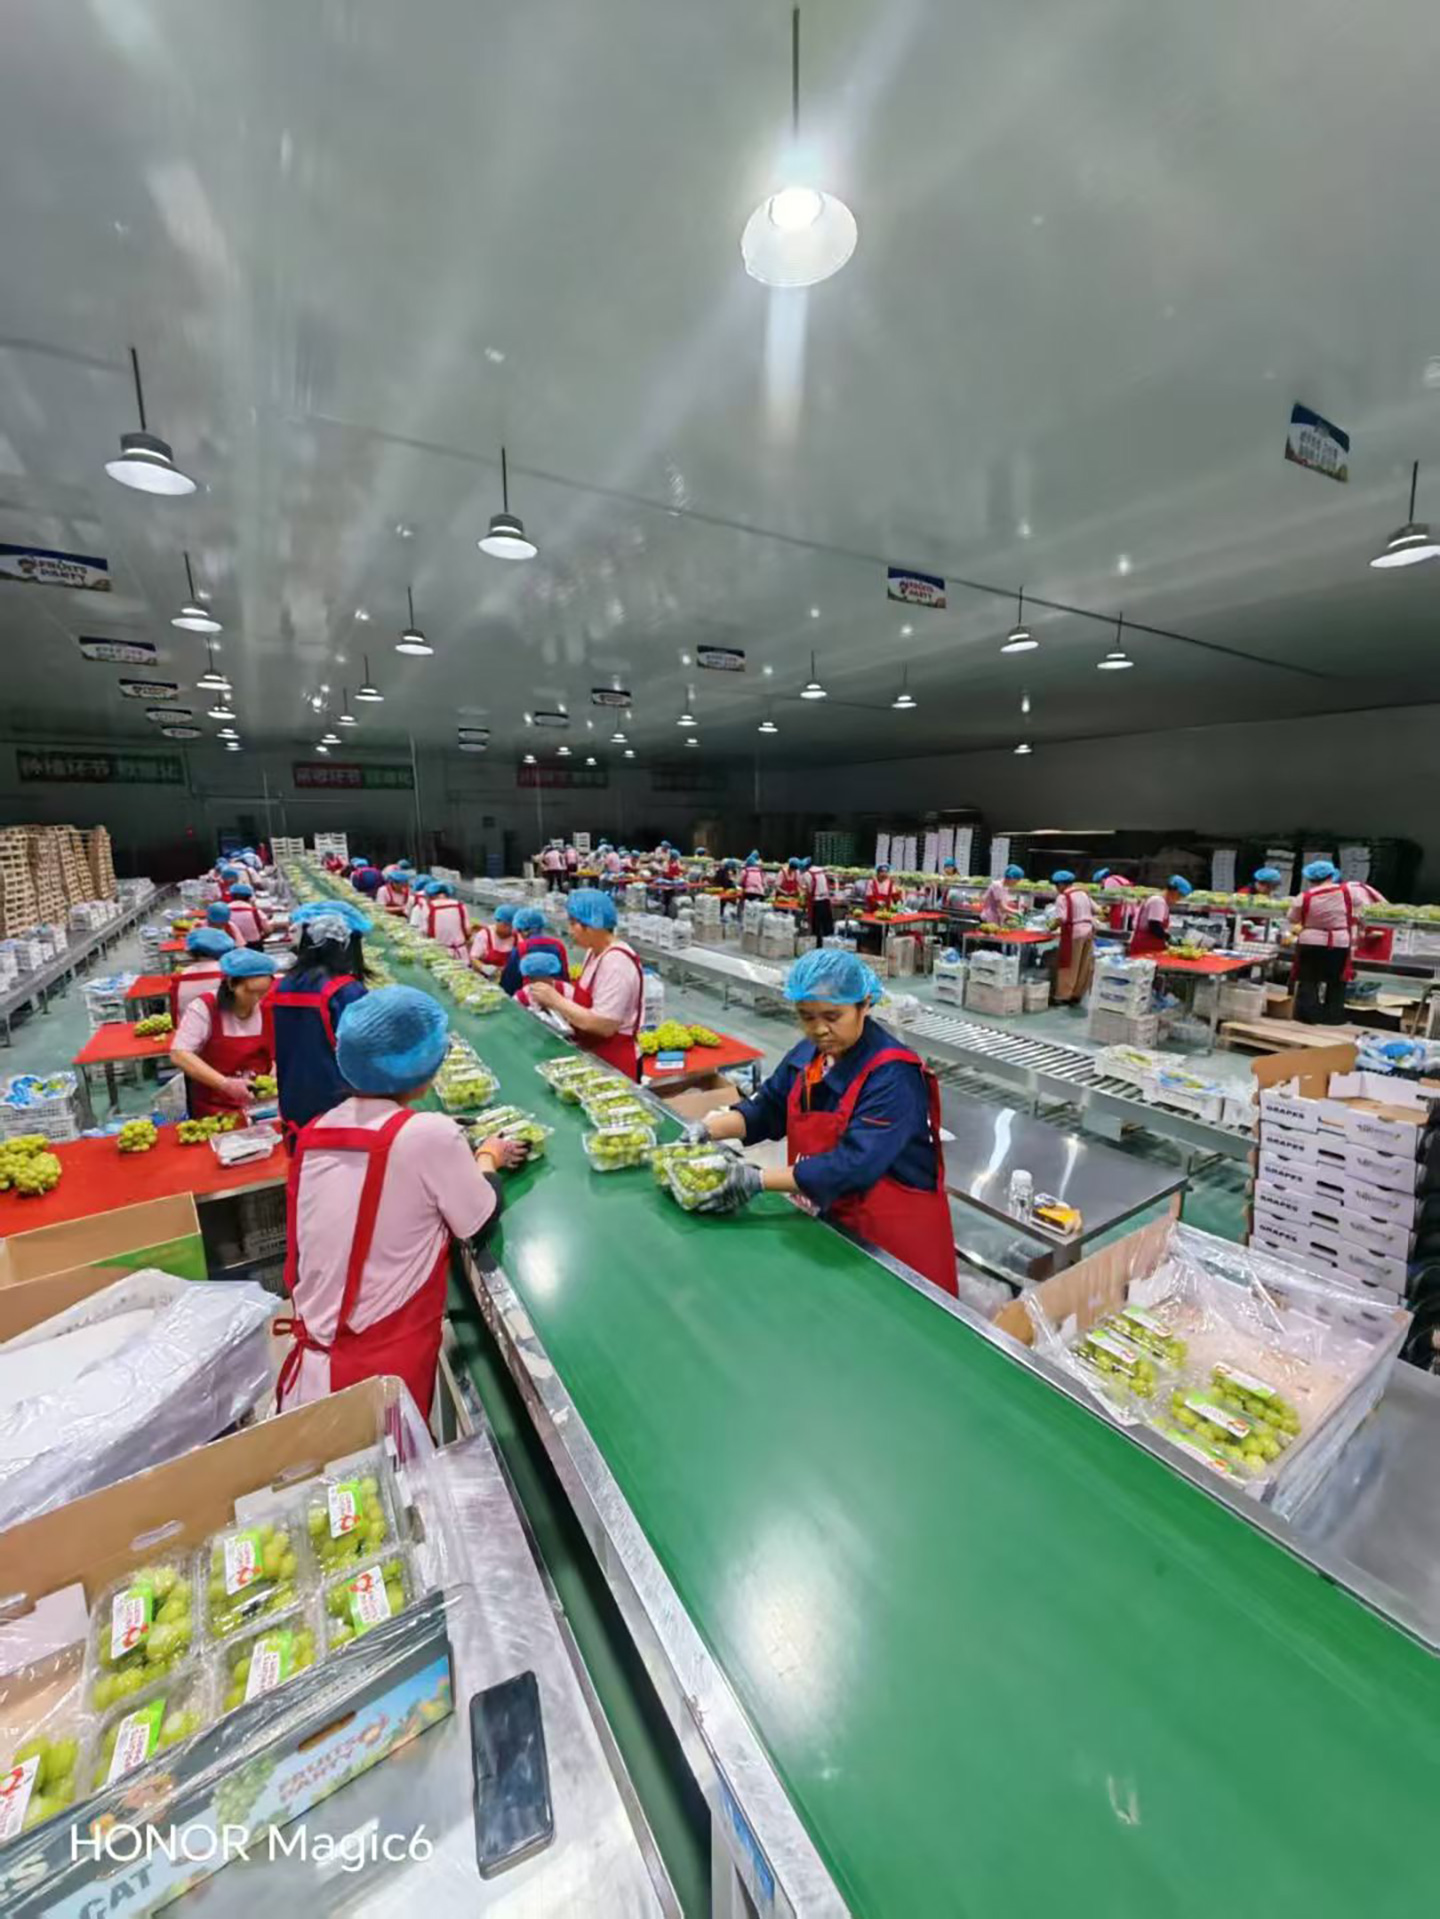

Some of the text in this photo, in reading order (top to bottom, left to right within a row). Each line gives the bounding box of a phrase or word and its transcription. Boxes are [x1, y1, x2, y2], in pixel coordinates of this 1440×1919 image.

[1265, 1105, 1305, 1119] GRAPES
[1265, 1136, 1305, 1151] GRAPES
[1264, 1166, 1303, 1183] GRAPES
[1260, 1194, 1299, 1213] GRAPES
[1258, 1224, 1298, 1243] GRAPES
